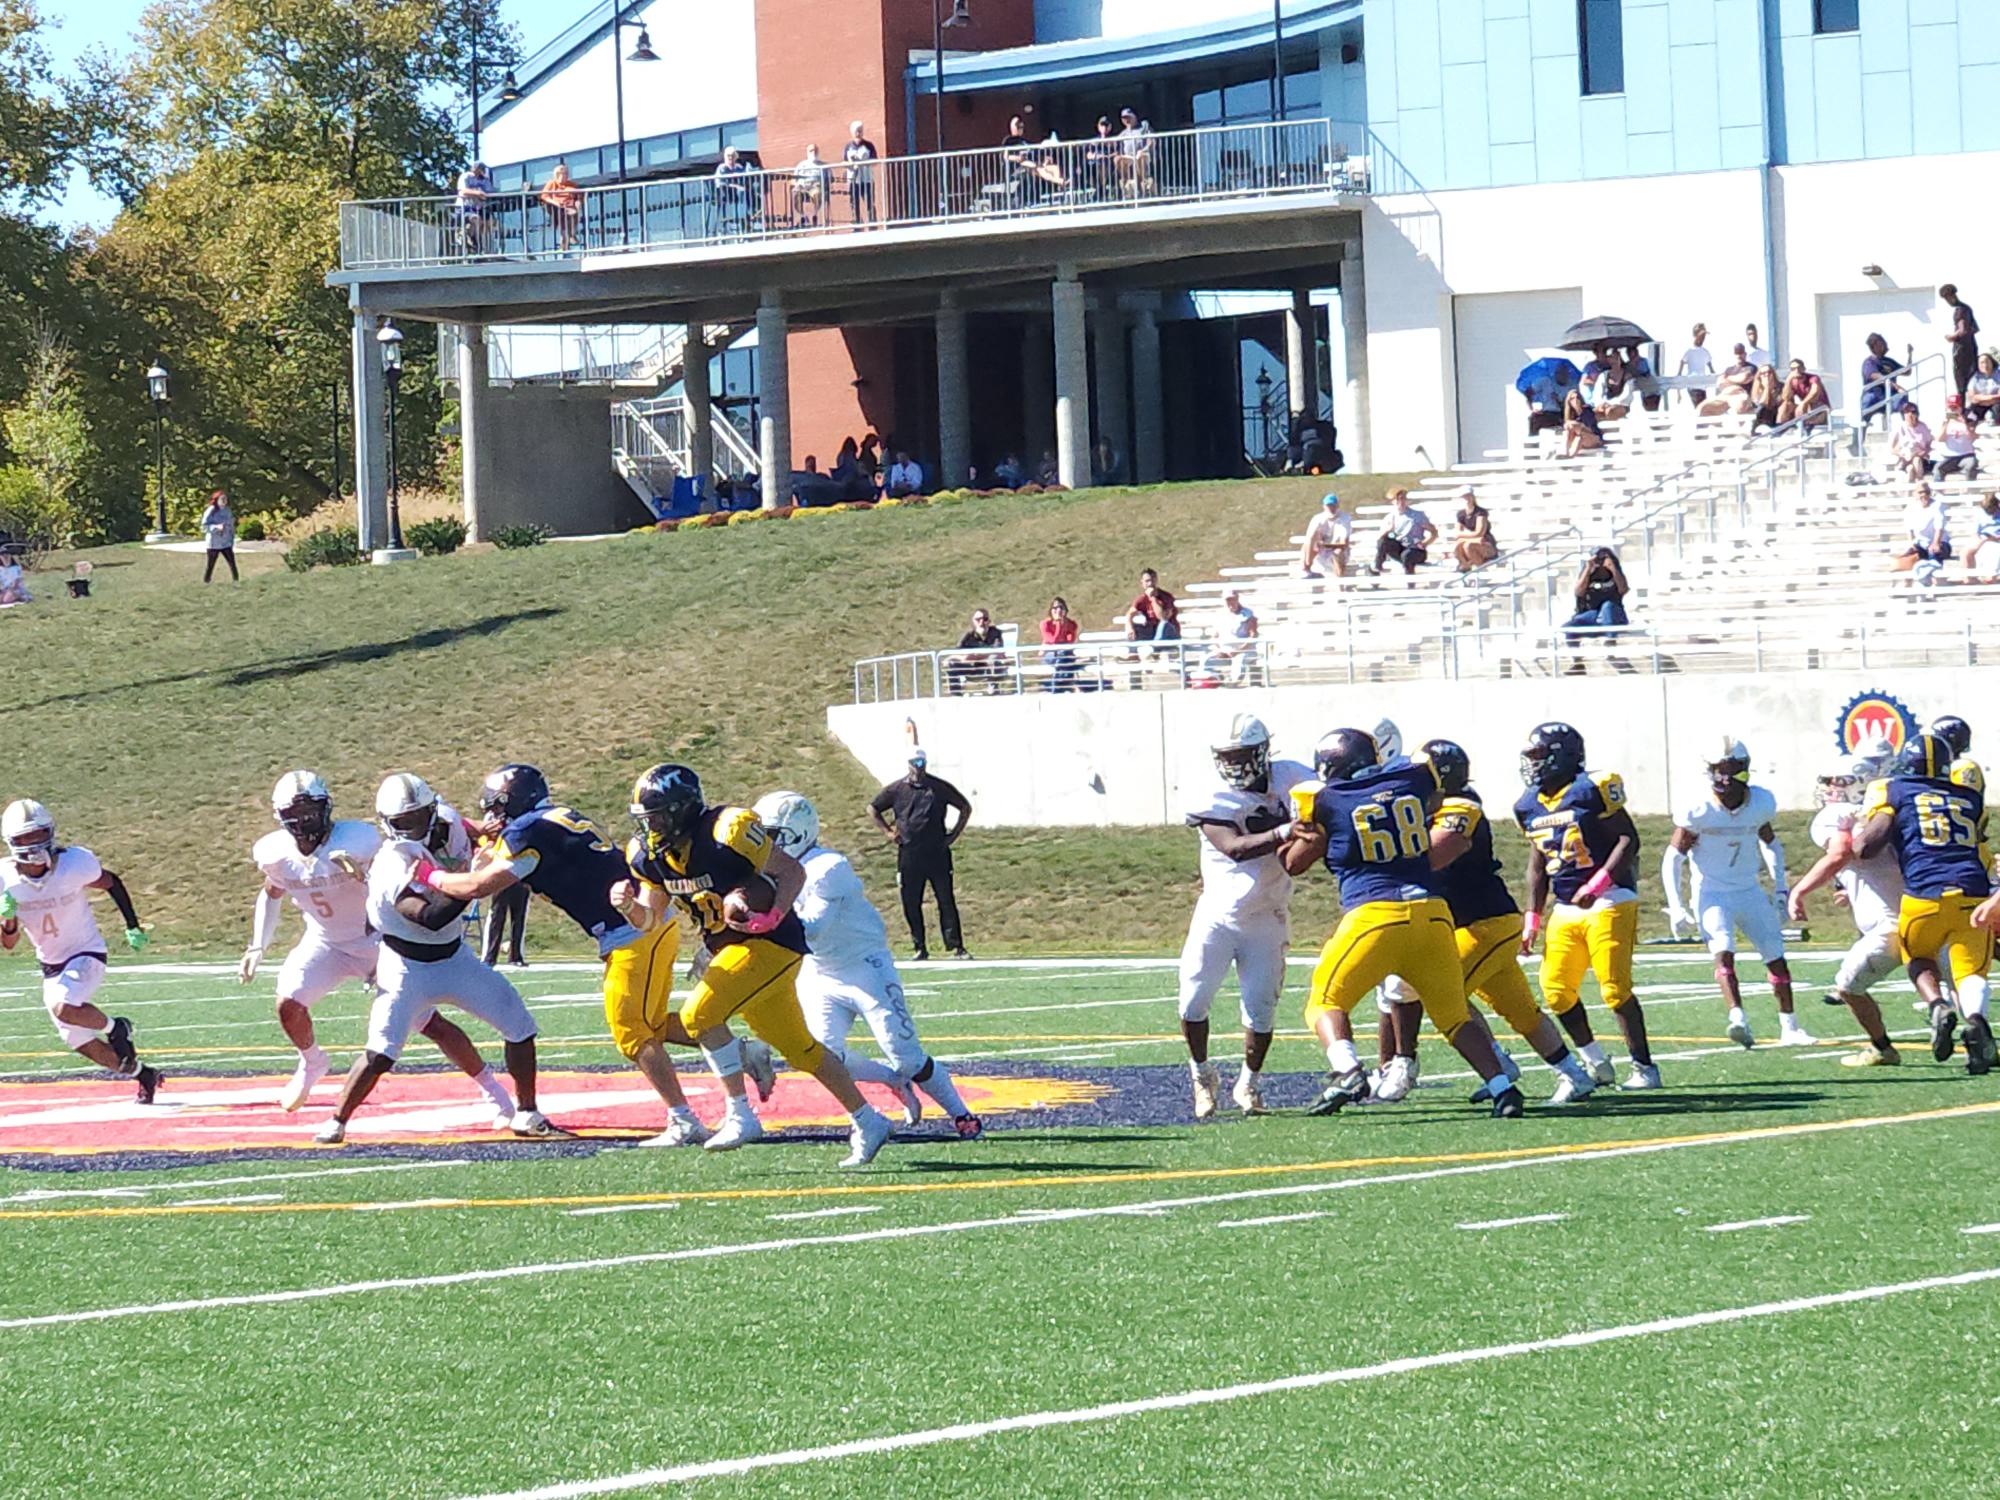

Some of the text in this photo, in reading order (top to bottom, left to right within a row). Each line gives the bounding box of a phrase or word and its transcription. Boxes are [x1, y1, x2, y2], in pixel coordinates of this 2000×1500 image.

[1352, 794, 1429, 864] 68
[1914, 792, 1976, 848] 65
[1525, 821, 1595, 875] 54
[1727, 841, 1742, 868] 7
[42, 911, 60, 938] 4
[309, 891, 335, 918] 5
